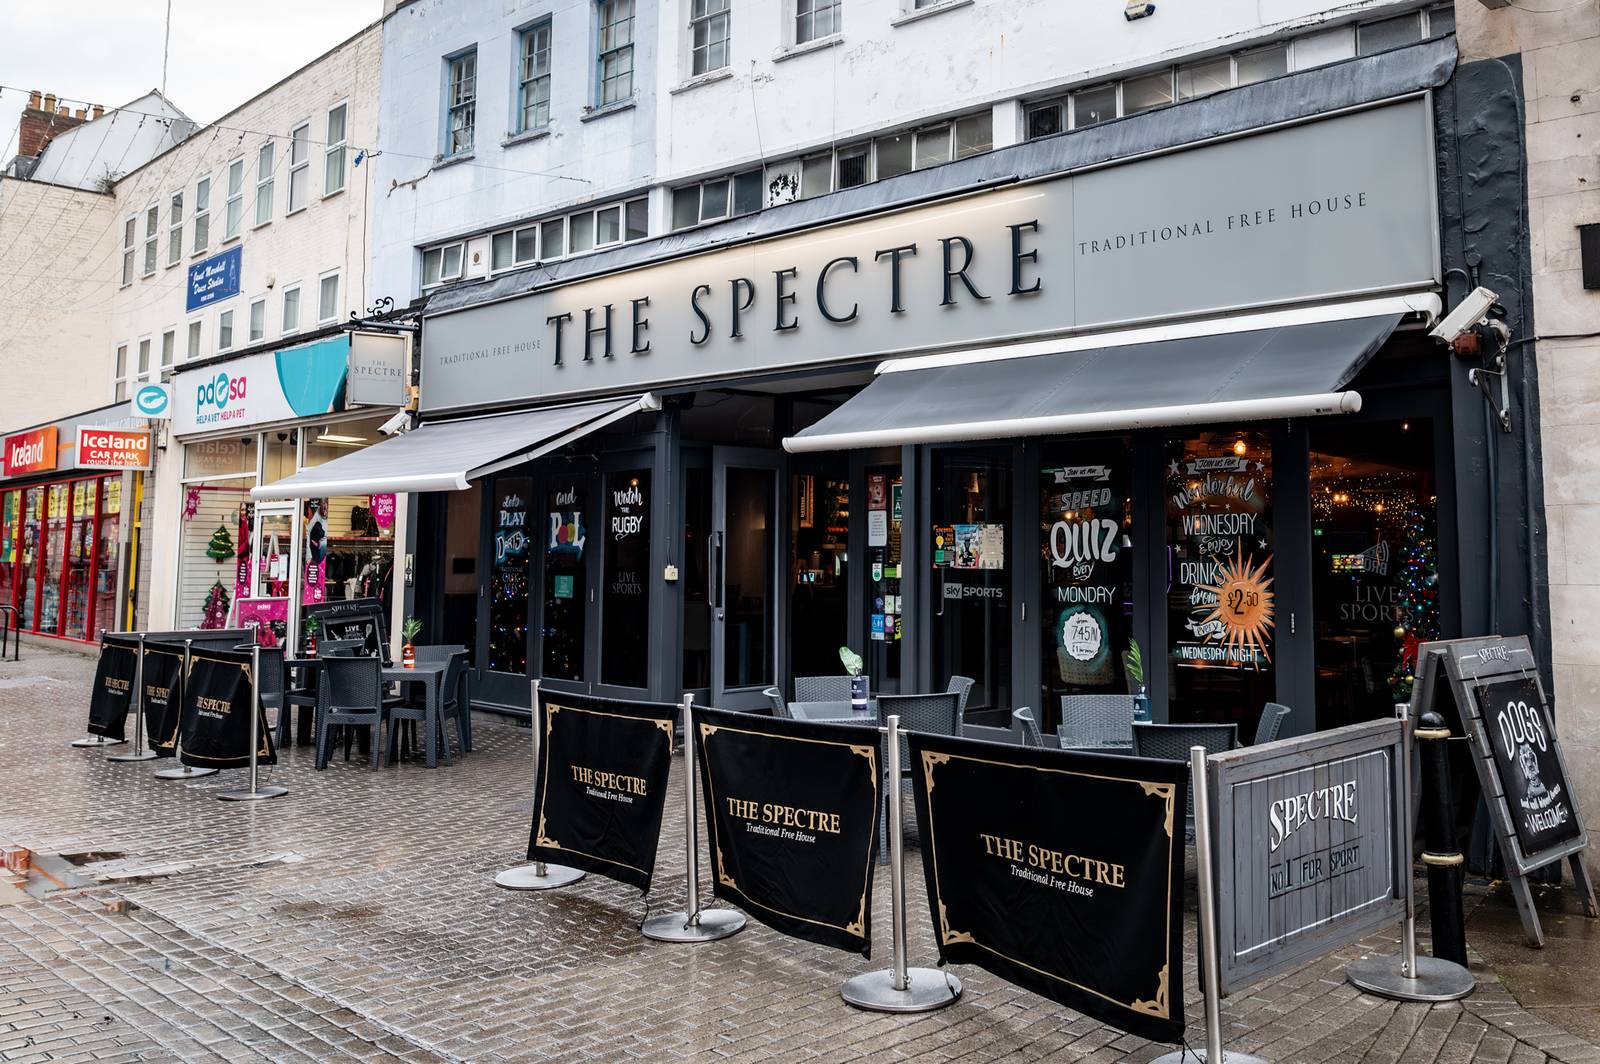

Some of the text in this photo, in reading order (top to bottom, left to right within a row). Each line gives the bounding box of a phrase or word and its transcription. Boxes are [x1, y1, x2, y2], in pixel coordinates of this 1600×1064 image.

[1079, 192, 1367, 255] TRADITIONAL FREE HOUSE
[546, 218, 1042, 366] THE SPECTRE
[440, 339, 541, 366] TRADITIONAL FREE HOUSE
[353, 366, 402, 377] SPECTRE
[11, 436, 44, 468] Iceland
[83, 433, 147, 451] Iceland
[90, 450, 139, 460] CAR PARK
[613, 486, 643, 506] Watch
[1060, 488, 1111, 511] SPEED
[1172, 474, 1255, 509] Wonderful
[499, 510, 526, 526] PLAY
[612, 516, 643, 533] RUGBY
[1182, 513, 1257, 535] WEDNESDAY
[1050, 519, 1118, 568] QUIZ
[618, 572, 635, 583] LIVE
[1181, 562, 1226, 585] DRINKS
[612, 583, 642, 594] SPORTS
[945, 585, 1003, 598] sky SPORTS
[1058, 586, 1116, 605] MONDAY
[1356, 585, 1398, 602] LIVE
[1340, 603, 1414, 620] SPORTS
[1181, 646, 1261, 662] WEDNESDAY NIGHT
[1497, 701, 1547, 760] DOGS
[571, 765, 647, 796] THE SPECTRE
[607, 791, 618, 801] Free
[618, 793, 633, 804] House
[727, 797, 841, 834] THE SPECTRE
[1270, 780, 1358, 854] SPECTRE
[746, 822, 816, 844] Traditional Free House
[980, 833, 1126, 888] THE SPECTRE
[1302, 858, 1323, 883] FOR
[1330, 845, 1359, 872] SPORT
[1010, 864, 1094, 898] Traditional Free House
